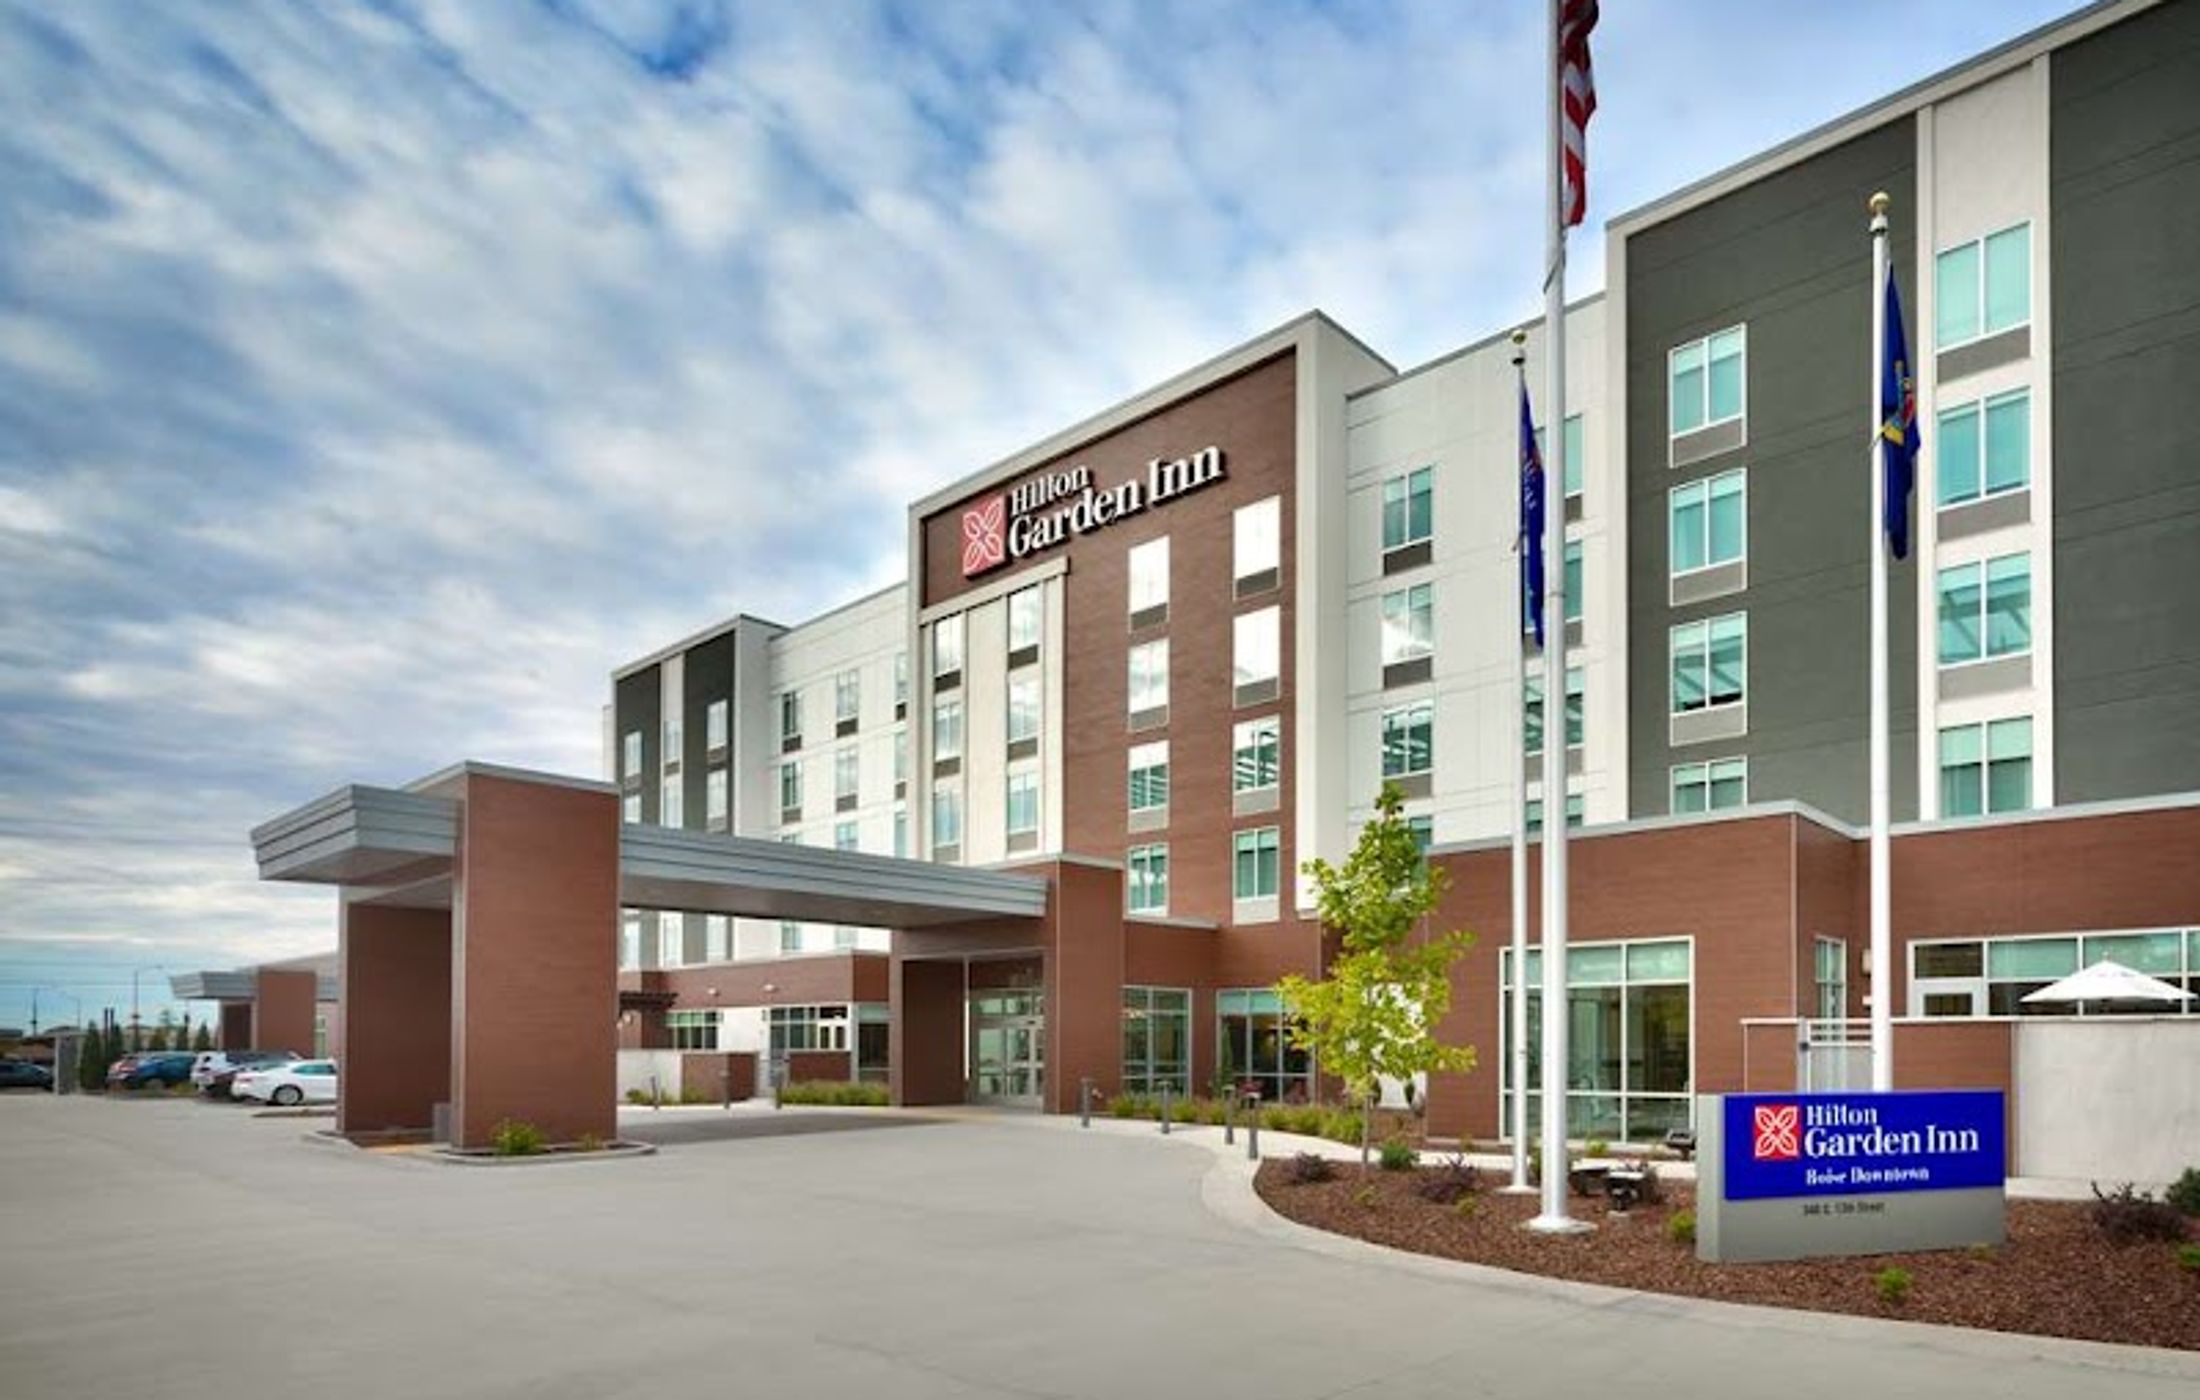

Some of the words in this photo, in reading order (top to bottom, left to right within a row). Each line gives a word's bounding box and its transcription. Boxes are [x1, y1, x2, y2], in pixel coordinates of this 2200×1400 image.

[1009, 478, 1141, 558] Garden
[1147, 445, 1224, 503] Inn
[1010, 465, 1089, 517] Hilton
[1806, 1104, 1878, 1126] Hilton
[1804, 1125, 1921, 1158] Garden
[1926, 1124, 1979, 1153] Inn
[1851, 1166, 1929, 1184] Downtown
